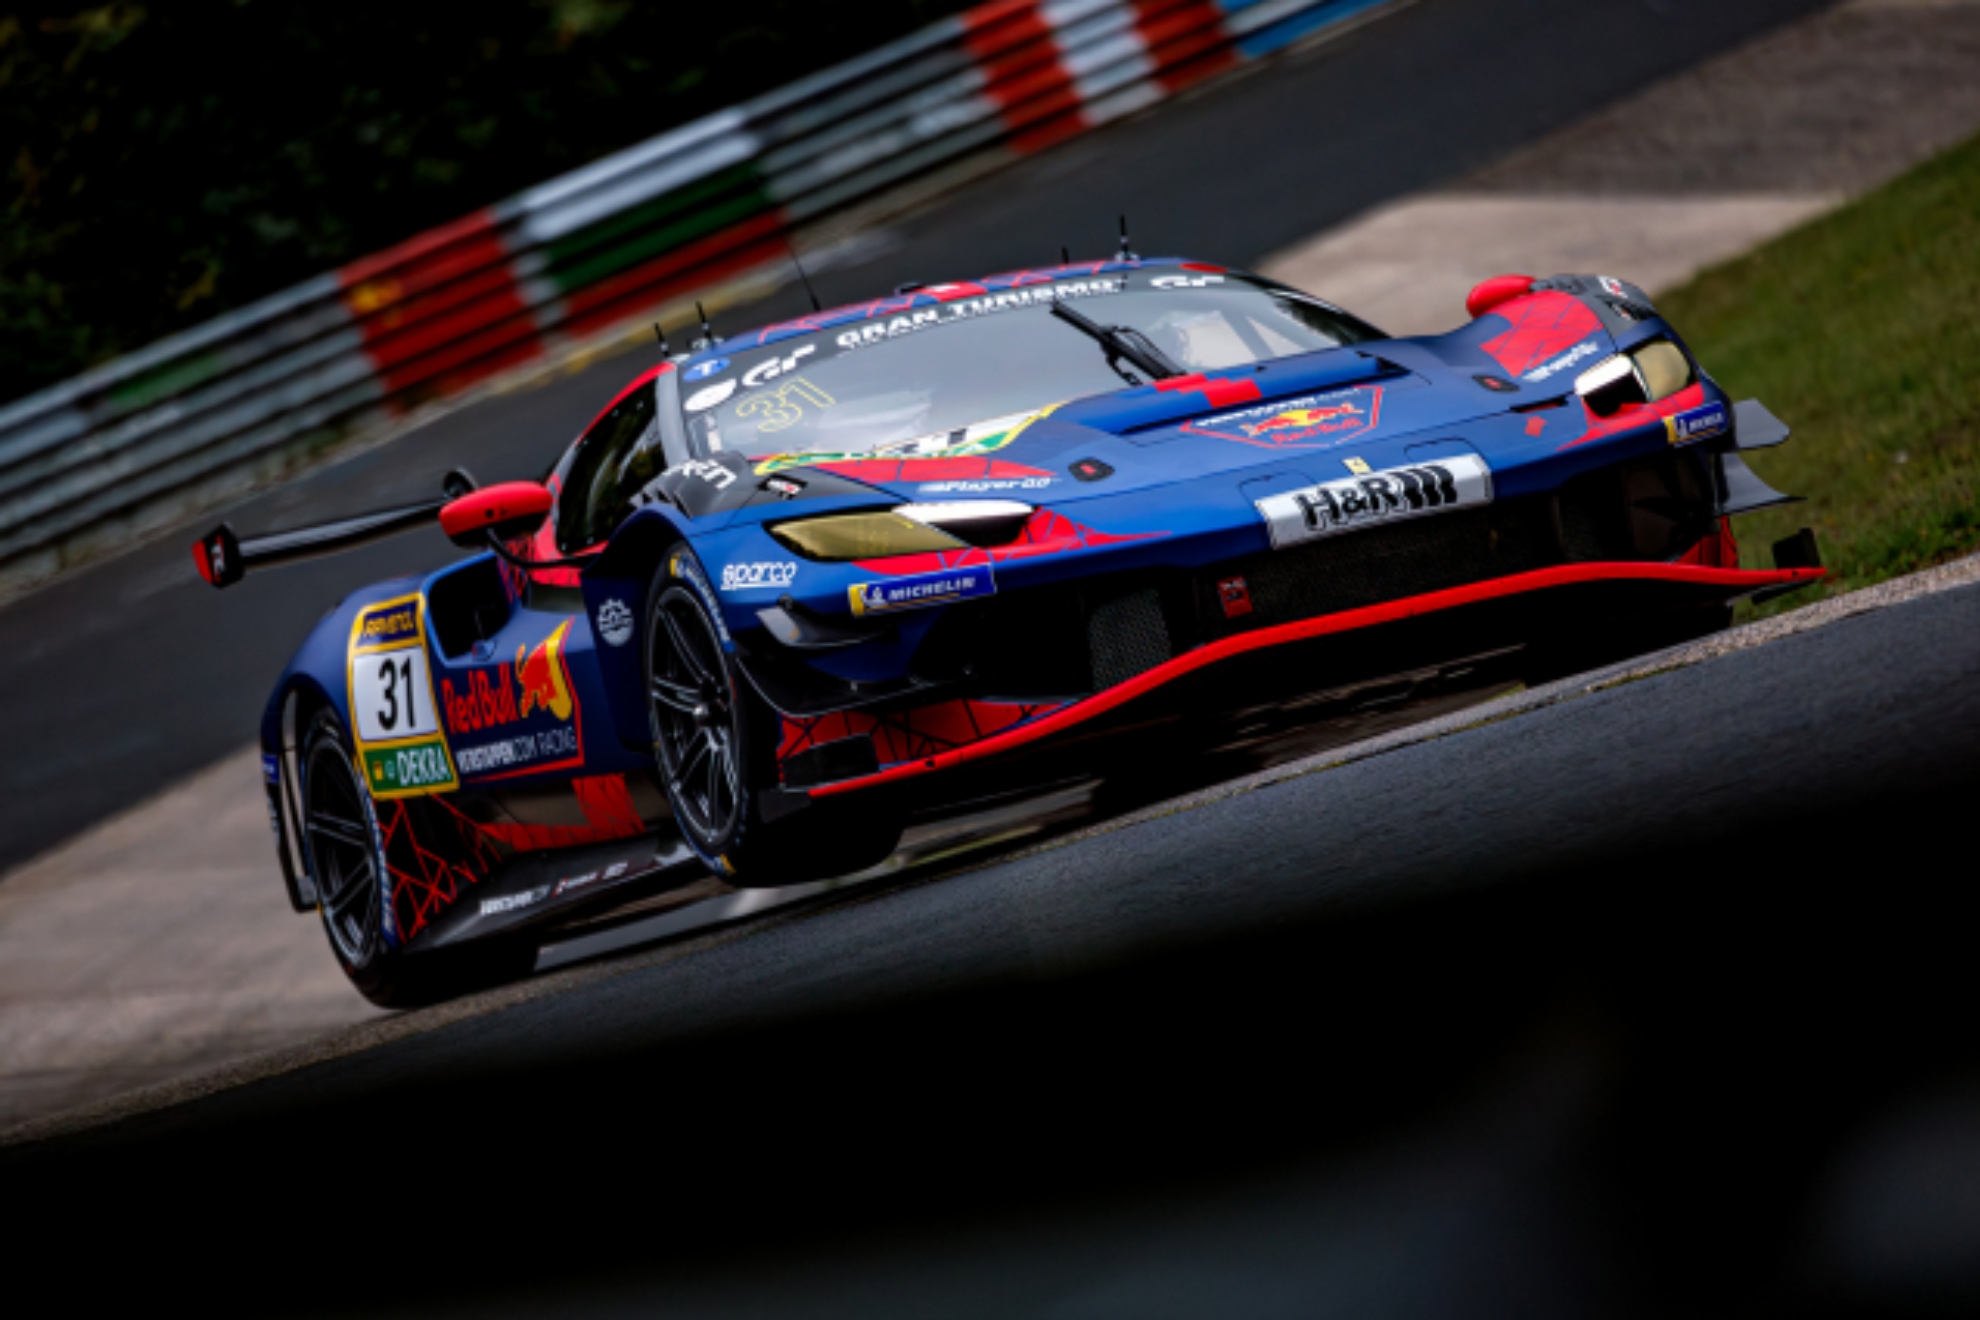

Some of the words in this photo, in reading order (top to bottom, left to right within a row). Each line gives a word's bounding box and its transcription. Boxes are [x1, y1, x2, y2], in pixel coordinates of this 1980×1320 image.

[836, 309, 939, 350] GRAN
[735, 377, 836, 433] 31
[1293, 477, 1398, 531] H&R
[720, 561, 798, 591] sparco
[887, 577, 976, 601] MICHELIN
[377, 656, 416, 731] 31
[441, 670, 483, 735] Red
[476, 661, 519, 728] Bull
[396, 746, 451, 787] DEKRA
